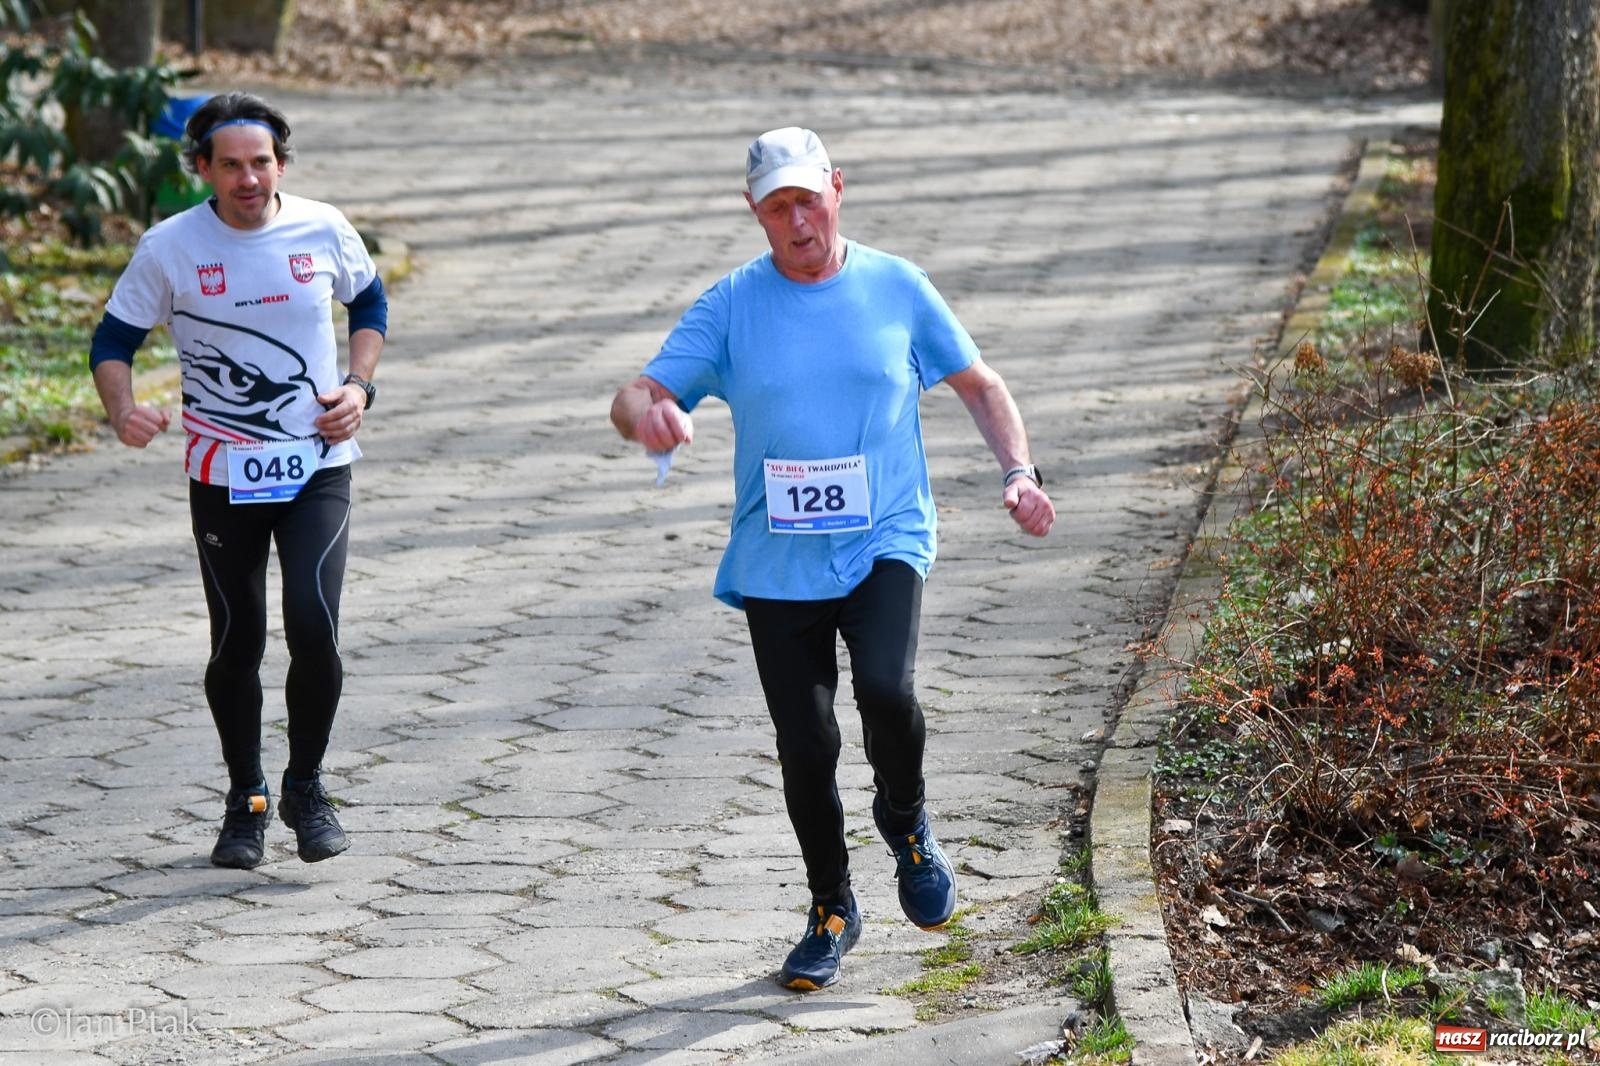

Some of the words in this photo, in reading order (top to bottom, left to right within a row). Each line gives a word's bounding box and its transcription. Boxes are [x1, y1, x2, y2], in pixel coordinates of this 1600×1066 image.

[243, 454, 305, 483] 048
[785, 464, 805, 474] BIEG
[787, 484, 846, 513] 128
